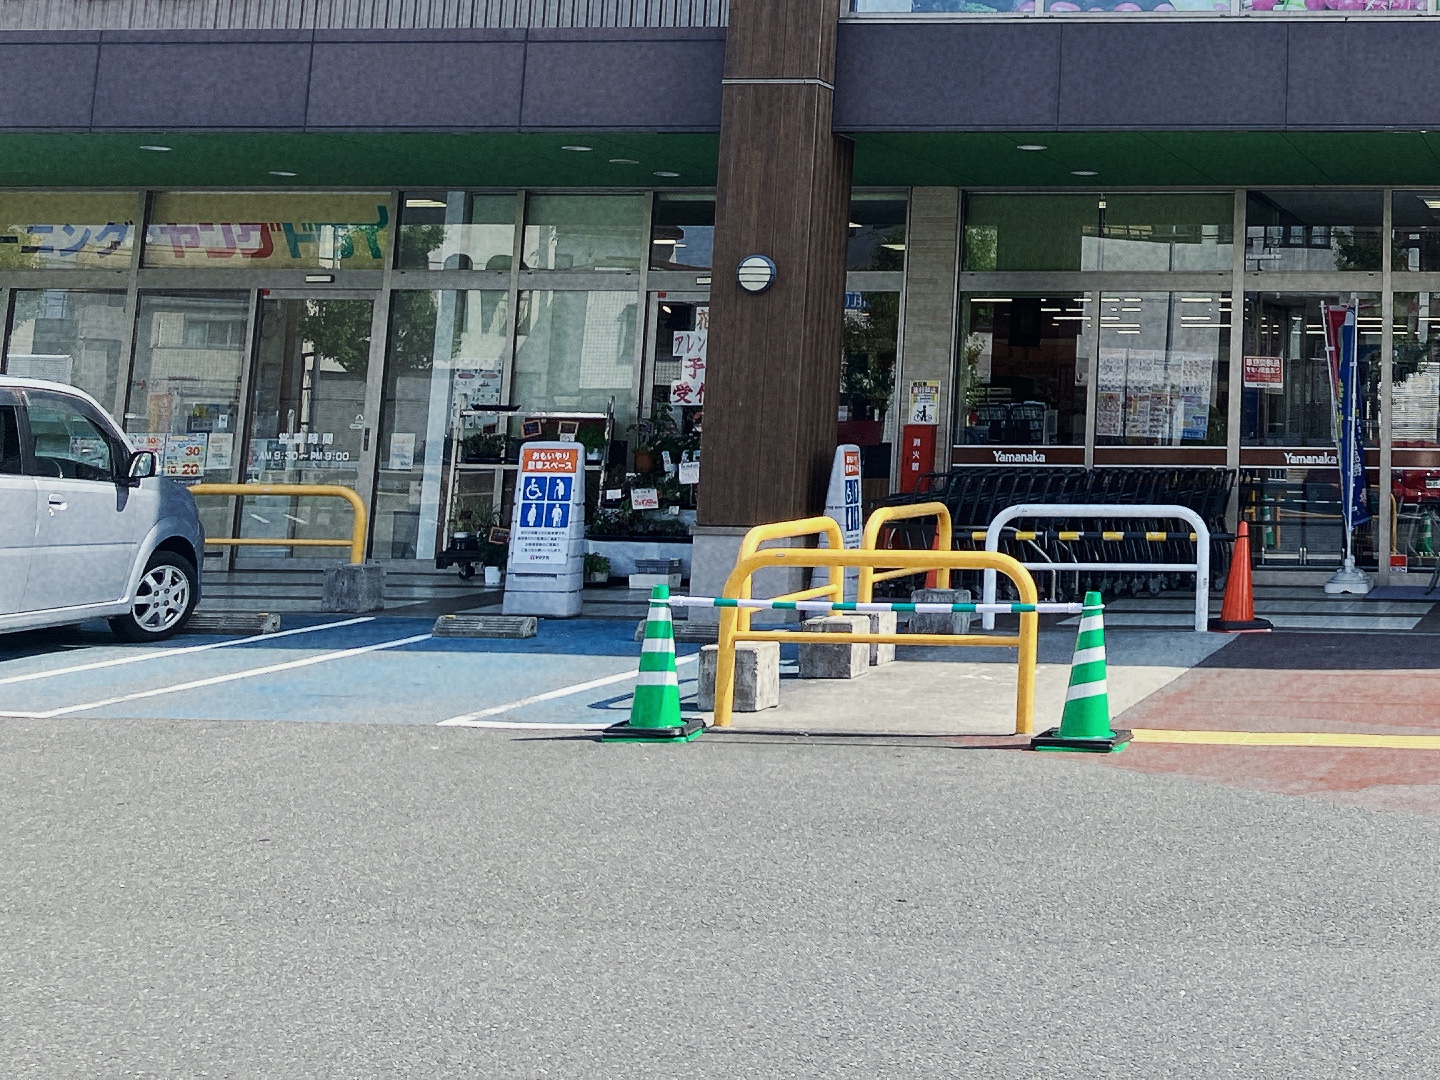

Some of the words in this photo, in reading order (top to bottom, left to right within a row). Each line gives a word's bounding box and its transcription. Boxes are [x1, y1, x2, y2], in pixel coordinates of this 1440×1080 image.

[532, 452, 569, 460] おもいやり
[993, 450, 1046, 462] Yamanaka
[1283, 451, 1337, 464] Yamanaka
